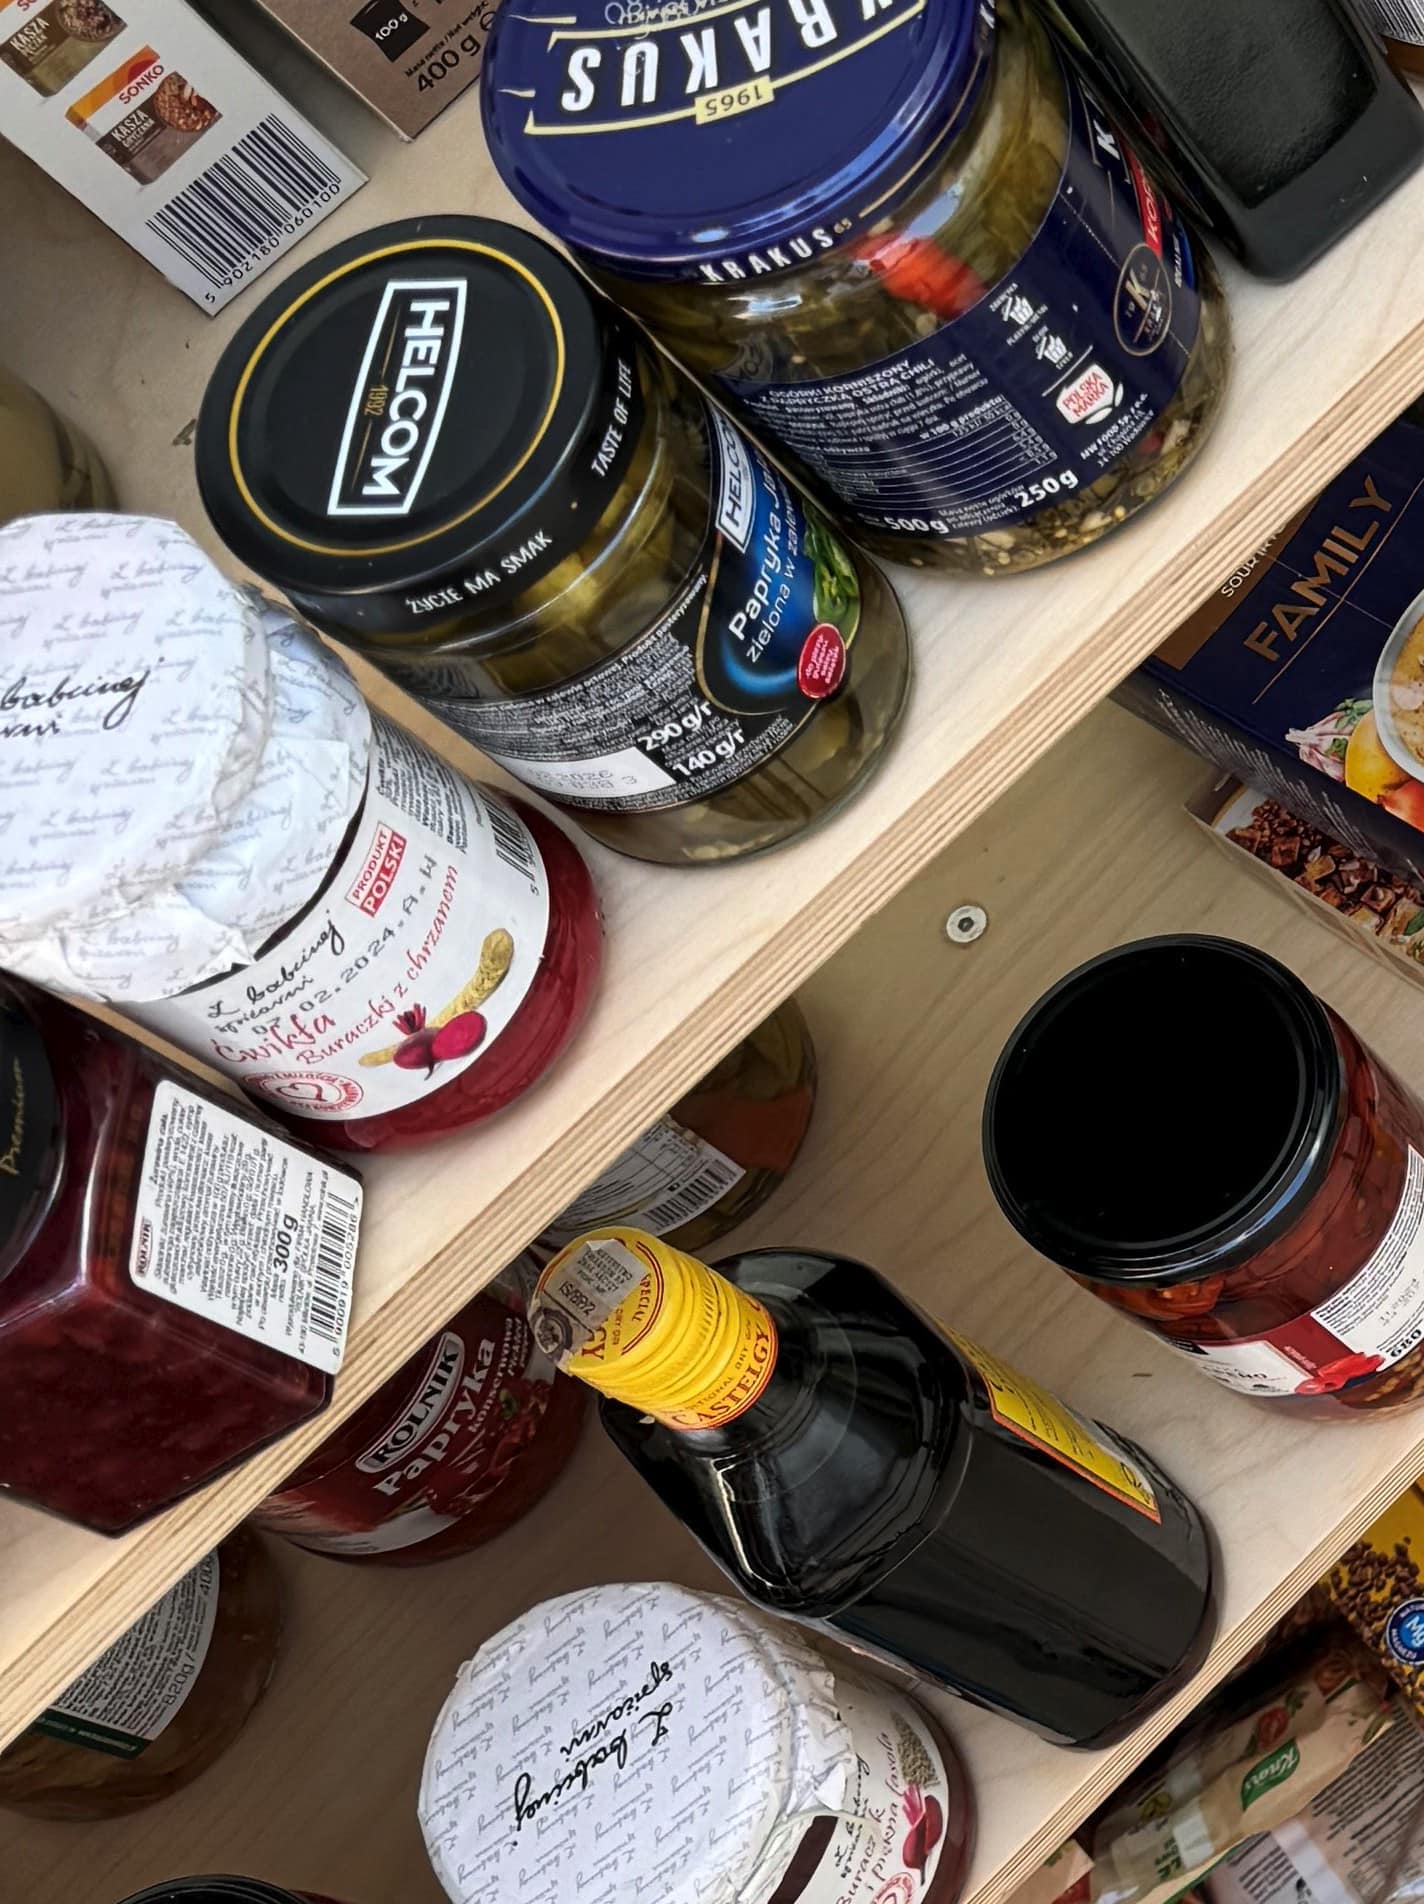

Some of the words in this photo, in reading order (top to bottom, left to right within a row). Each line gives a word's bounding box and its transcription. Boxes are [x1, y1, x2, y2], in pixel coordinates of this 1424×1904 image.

[8, 16, 51, 53] KASZA
[414, 47, 461, 96] 400
[458, 31, 483, 59] g
[117, 62, 166, 107] SONKO
[702, 83, 767, 120] 1965
[112, 107, 150, 144] KASZA
[221, 235, 282, 289] 902180
[282, 180, 342, 236] 060100
[700, 226, 837, 287] KRAKUS
[362, 300, 451, 498] HELCOM
[1060, 370, 1103, 410] POLSKA
[1071, 381, 1111, 418] MARKA
[591, 425, 623, 479] TASTE
[1013, 468, 1080, 510] 250g
[883, 515, 949, 535] 500g
[404, 578, 464, 617] ŻYCIE
[464, 565, 502, 599] MA
[498, 529, 554, 576] SMAK
[728, 516, 783, 641] Papryka
[1241, 474, 1394, 663] FAMILY
[745, 583, 794, 664] zielona
[351, 828, 390, 901] PRODUKT
[365, 831, 408, 914] POLSKI
[209, 1012, 337, 1064] Ćwikła
[295, 992, 398, 1066] Buraczki
[373, 1343, 460, 1465] ROLNIK
[669, 1326, 770, 1428] CASTELGY
[372, 1338, 497, 1497] Papryka
[1244, 1744, 1299, 1797] Knorr
